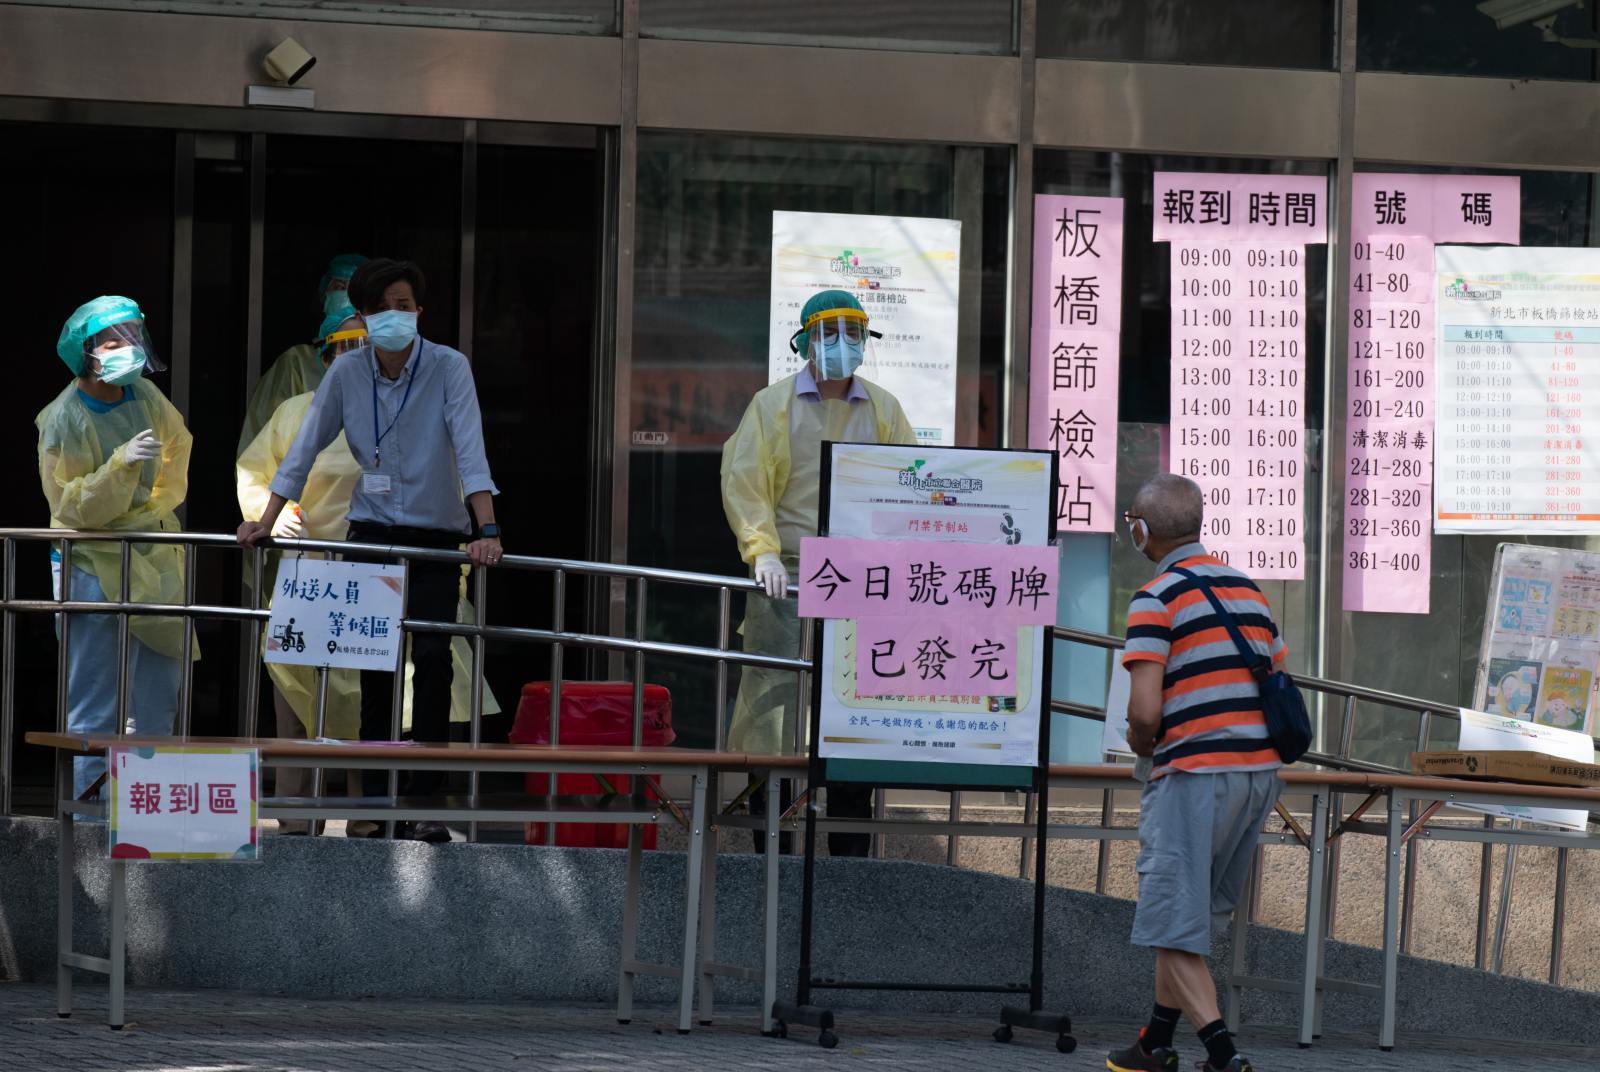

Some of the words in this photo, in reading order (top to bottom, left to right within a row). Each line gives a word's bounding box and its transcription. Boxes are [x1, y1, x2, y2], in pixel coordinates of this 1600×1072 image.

[1163, 189, 1231, 225] 報到
[1249, 192, 1316, 227] 時間
[1180, 248, 1231, 267] 09:00
[1247, 249, 1298, 267] 09:10
[1353, 242, 1405, 261] 01-40
[1181, 278, 1231, 297] 10:00
[1248, 279, 1298, 298] 10:10
[1353, 273, 1409, 293] 41-80
[1181, 308, 1231, 327] 11:00
[1248, 309, 1298, 328] 11:10
[1353, 308, 1420, 329] 81-120
[1181, 338, 1231, 357] 12:00
[1248, 339, 1298, 358] 12:10
[1354, 340, 1425, 359] 121-160
[1456, 345, 1511, 355] 09:00-09:10
[1049, 207, 1101, 526] 板橋篩檢站
[1456, 361, 1511, 370] 10:00-10:10
[1181, 367, 1231, 386] 13:00
[1248, 368, 1298, 387] 13:10
[1354, 369, 1425, 388] 161-200
[1456, 376, 1511, 386] 11:00-11:10
[1456, 392, 1511, 402] 12:00-12:10
[1181, 398, 1231, 416] 14:00
[1247, 399, 1297, 417] 14:10
[1353, 399, 1424, 418] 201-240
[1456, 408, 1511, 417] 13:00-13:10
[1180, 428, 1231, 446] 15:00
[1247, 429, 1297, 447] 16:00
[1456, 423, 1511, 433] 14:00-14:10
[1352, 428, 1428, 450] 清潔消毒
[1456, 439, 1511, 449] 15:00-16:00
[1180, 458, 1230, 476] 16:00
[1247, 459, 1297, 477] 16:10
[1350, 457, 1421, 477] 241-280
[1456, 455, 1511, 465] 16:00-16:10
[1456, 470, 1511, 480] 17:00-17:10
[1247, 488, 1296, 506] 17:10
[1350, 488, 1421, 507] 281-320
[1456, 486, 1511, 496] 18:00-18:10
[1456, 502, 1511, 512] 19:00-19:10
[908, 519, 968, 533] 門禁管制站
[1247, 518, 1296, 536] 18:10
[1349, 518, 1420, 537] 321-360
[1248, 550, 1297, 569] 19:10
[1349, 551, 1420, 571] 361-400
[282, 578, 360, 605] 外送人員
[806, 557, 1050, 611] 今日號碼牌
[328, 611, 390, 639] 等候區
[870, 635, 1009, 681] 已發完
[121, 755, 126, 768] 1
[129, 782, 239, 815] 報到區
